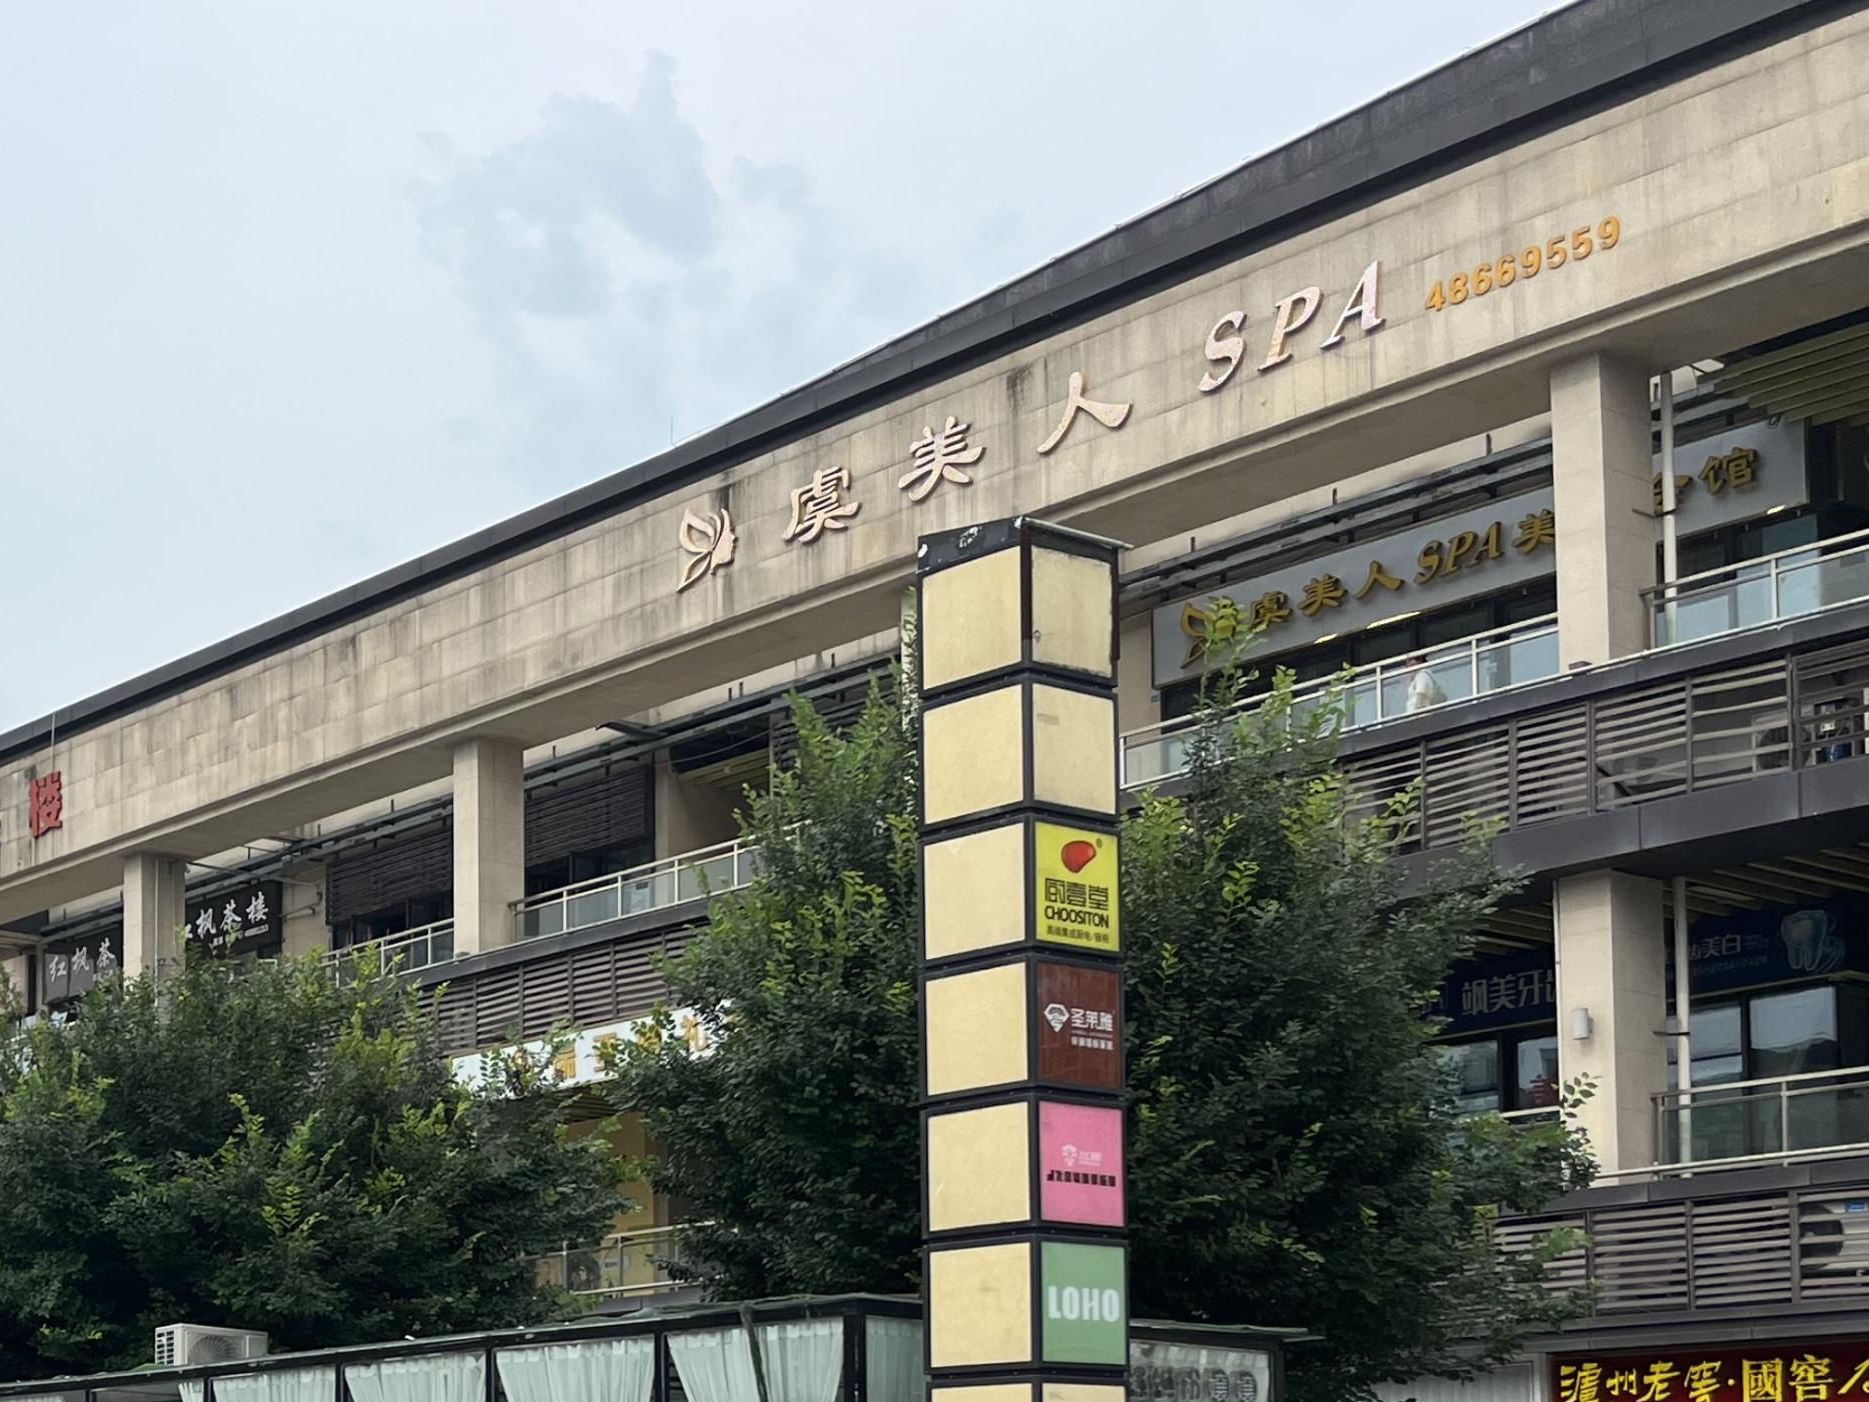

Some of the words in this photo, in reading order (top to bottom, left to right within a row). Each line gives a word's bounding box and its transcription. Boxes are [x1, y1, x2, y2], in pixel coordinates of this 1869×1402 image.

[1424, 214, 1623, 312] 48669559
[782, 371, 1131, 545] 虞美人
[1196, 259, 1387, 395] SPA
[1044, 905, 1109, 928] CHOOSITON
[1047, 1285, 1120, 1323] LOHO
